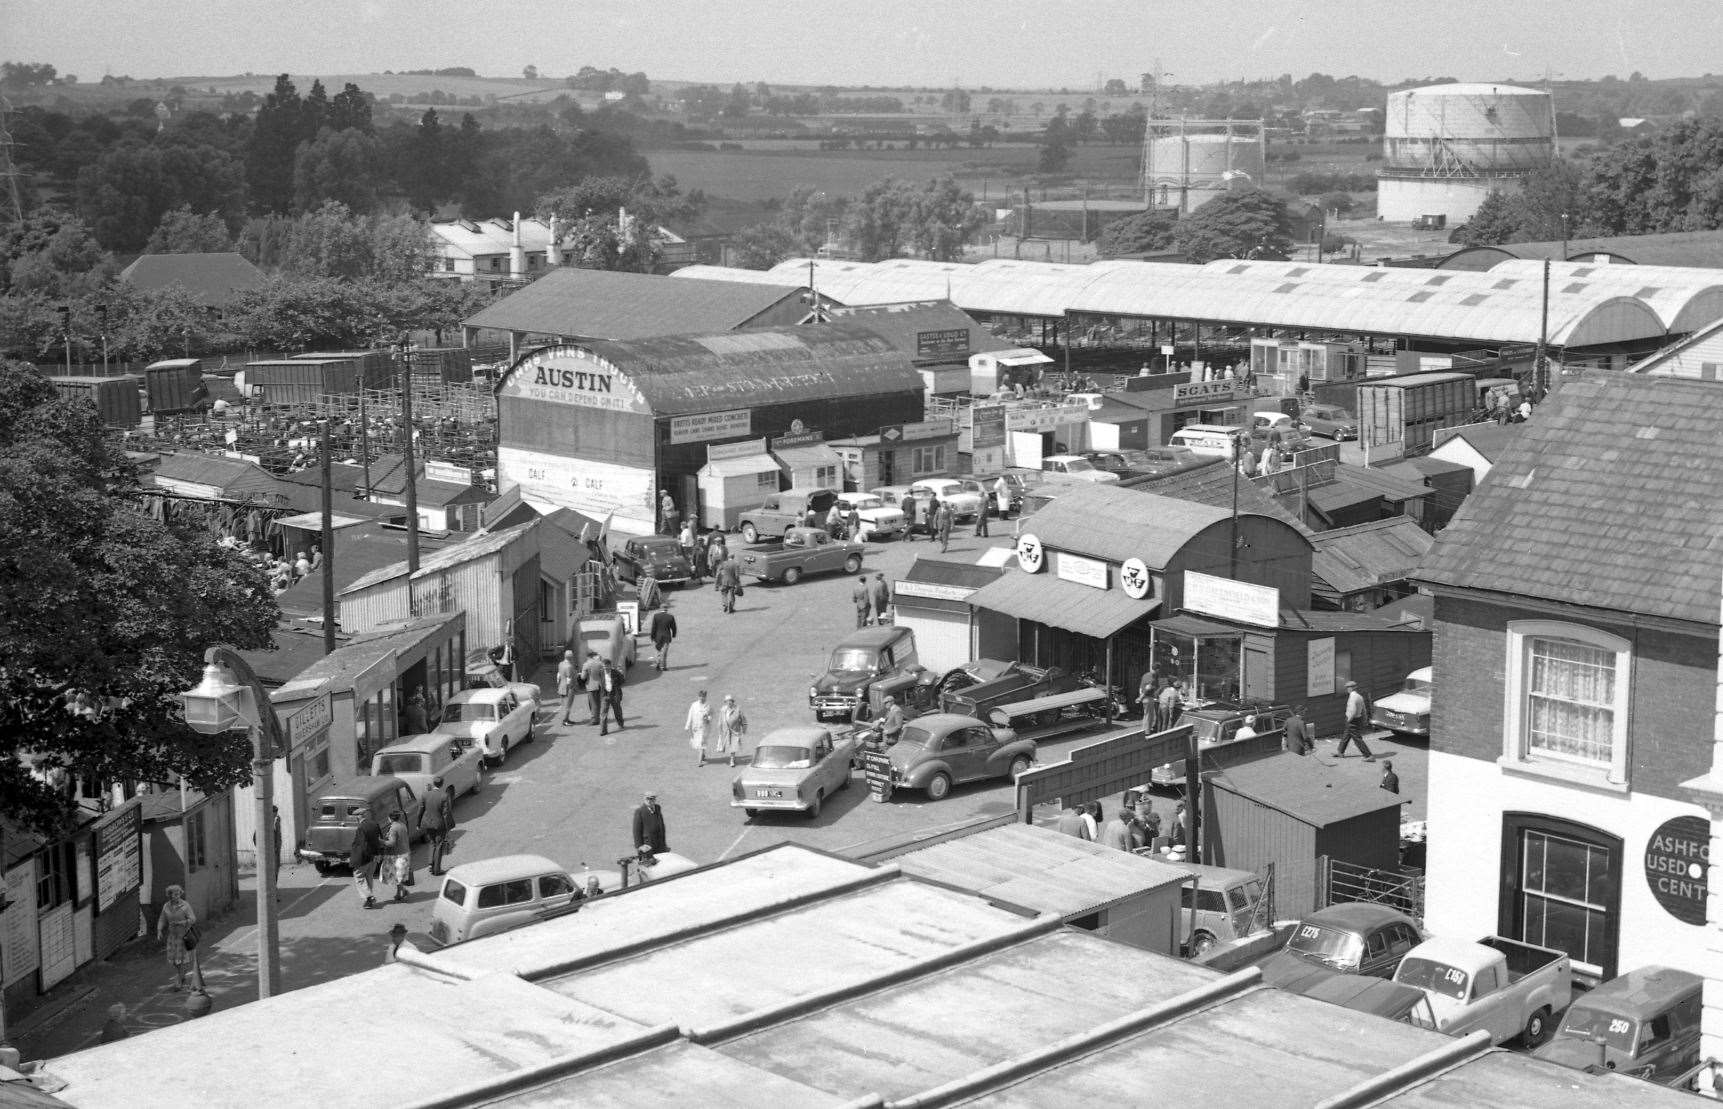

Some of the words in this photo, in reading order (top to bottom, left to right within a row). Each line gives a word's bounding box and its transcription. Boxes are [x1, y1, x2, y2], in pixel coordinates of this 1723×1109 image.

[547, 348, 586, 360] VANS
[534, 366, 613, 393] AUSTIN
[529, 388, 546, 399] YOU
[549, 389, 566, 401] CAN
[567, 391, 599, 405] DEPEND
[600, 395, 613, 407] ON
[1177, 382, 1231, 397] SCATS
[1647, 853, 1687, 877] USED
[1608, 1018, 1630, 1034] 250
